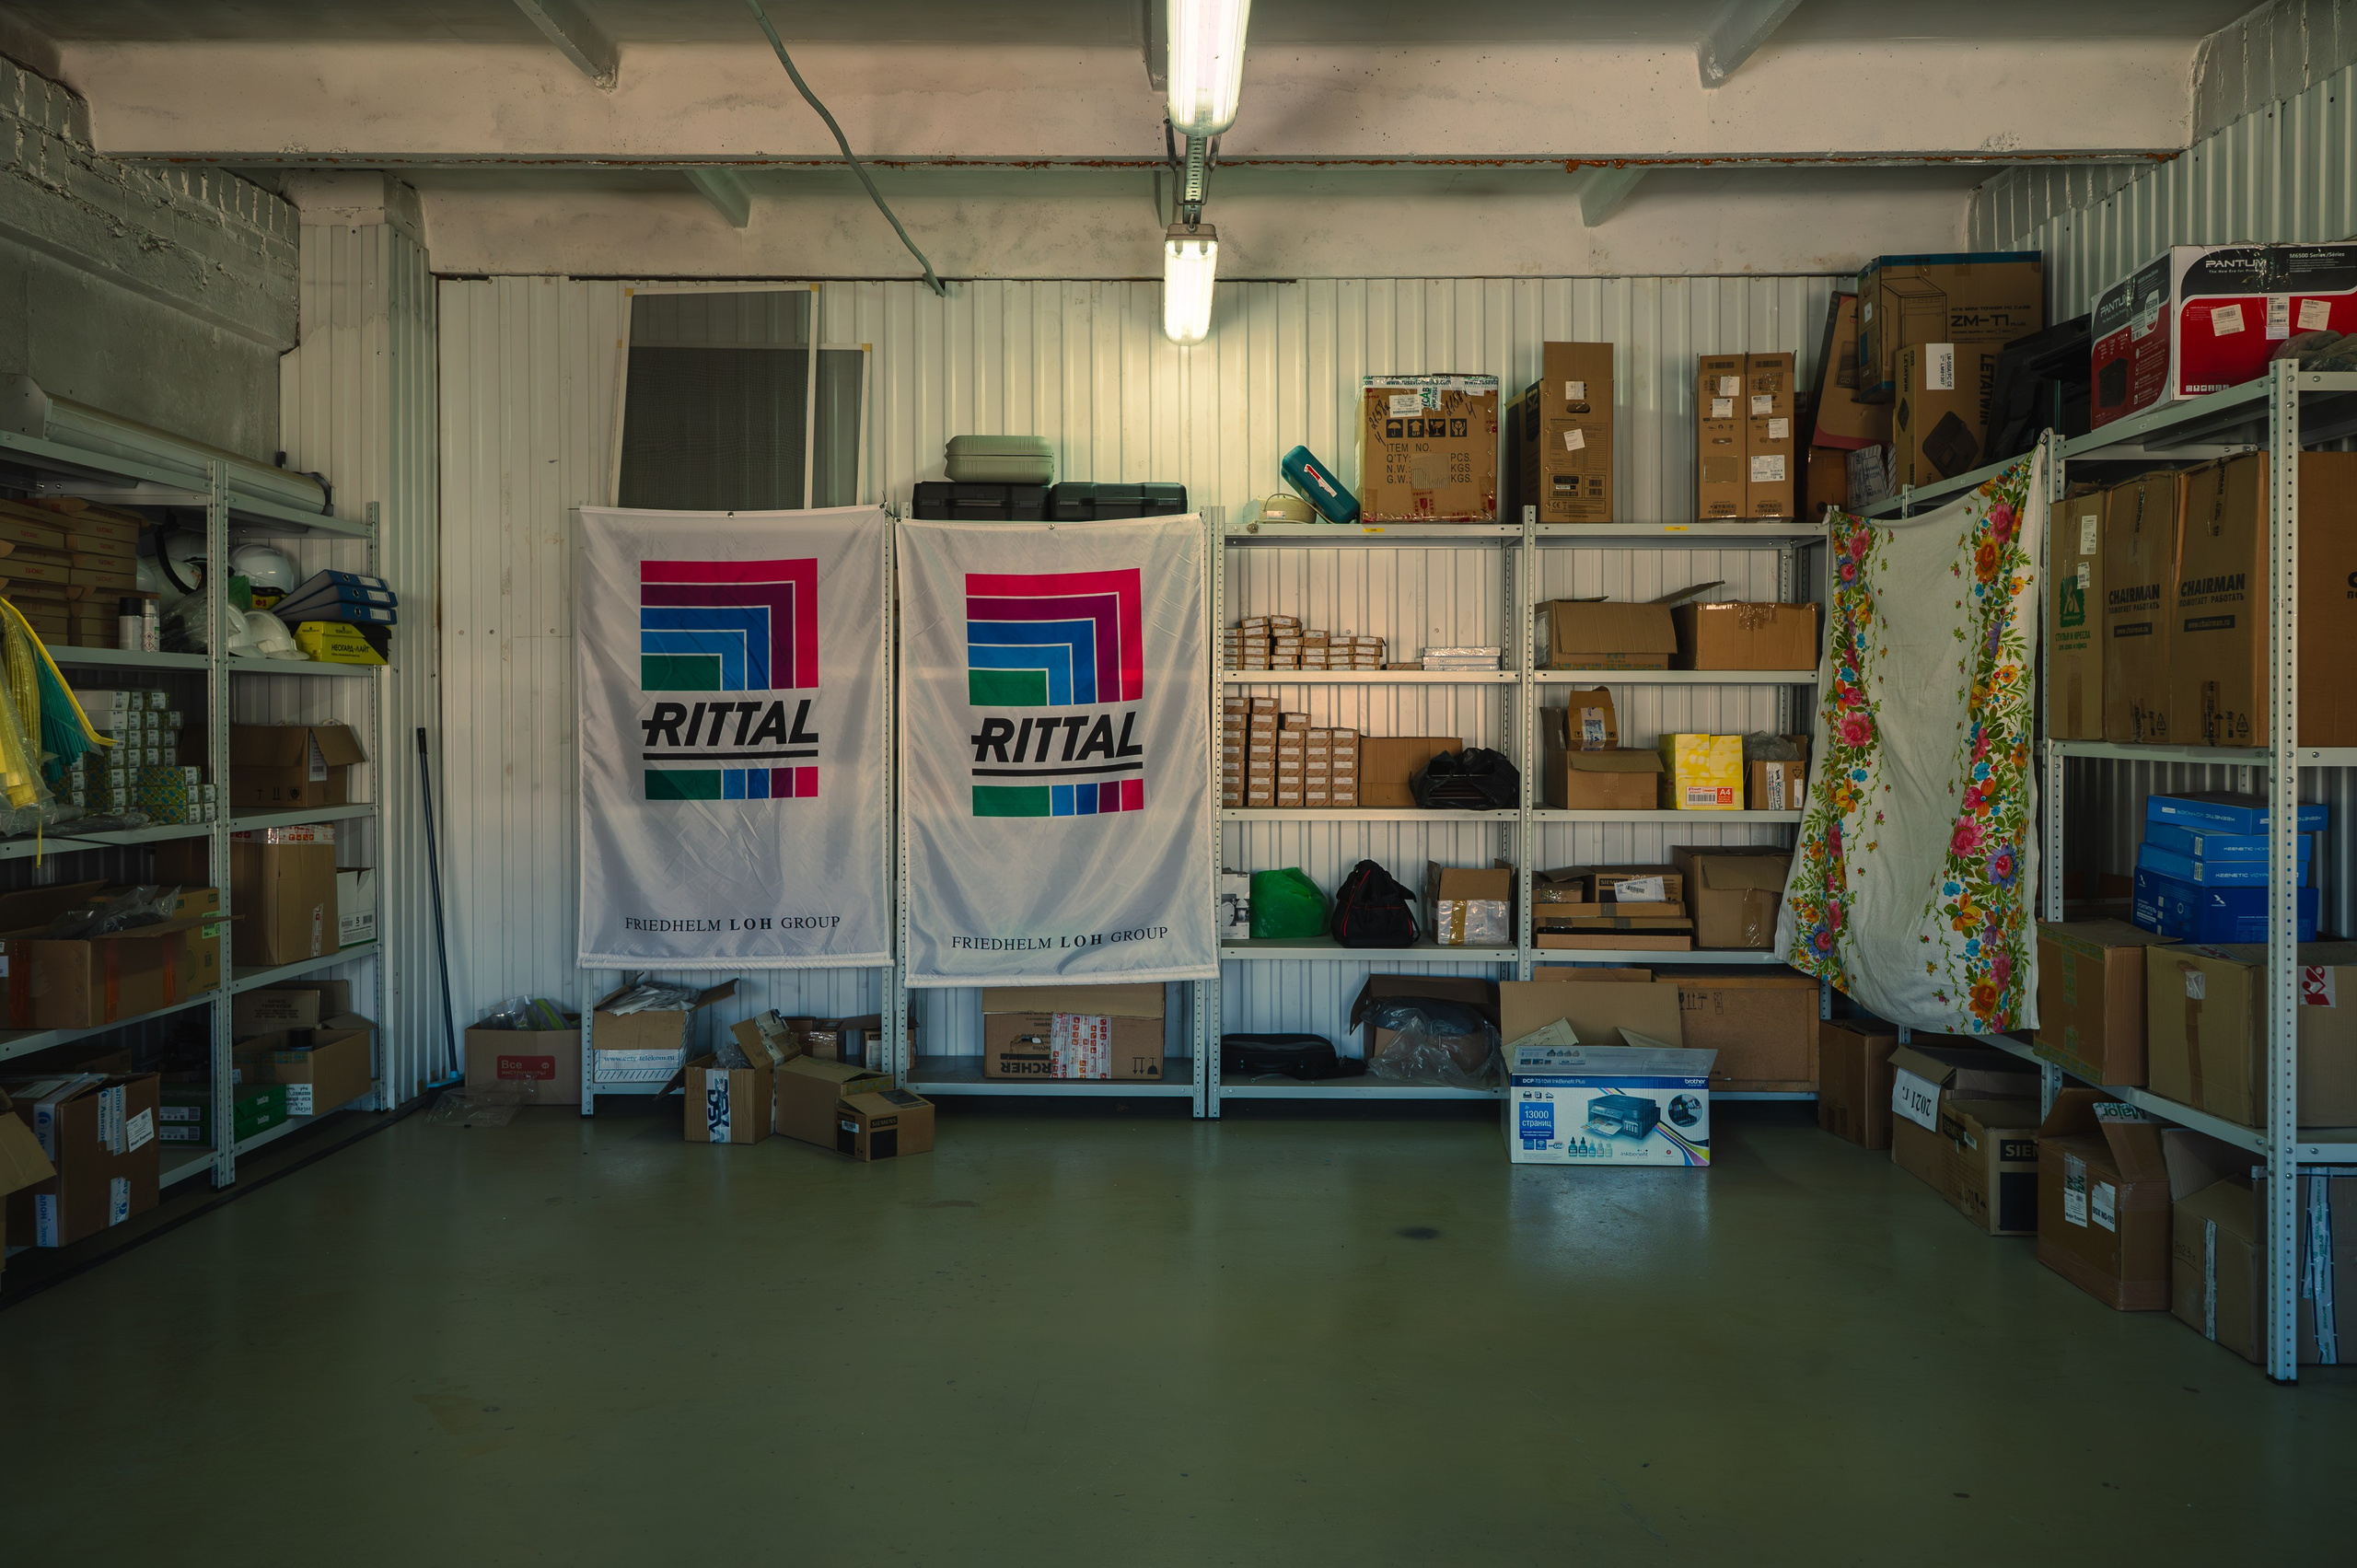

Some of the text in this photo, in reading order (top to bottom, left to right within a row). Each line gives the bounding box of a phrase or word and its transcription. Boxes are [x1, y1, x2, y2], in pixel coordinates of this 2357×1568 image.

[2205, 259, 2267, 268] PANTUM
[1980, 353, 1995, 425] LETATWIN
[1386, 443, 1432, 452] ITEM NO.
[1386, 453, 1472, 463] Q'TY: PCS.
[1450, 464, 1472, 472] KGS.
[1450, 474, 1472, 482] KGS.
[2180, 573, 2247, 597] CHAIRMAN
[2108, 584, 2160, 605] CHAIRMAN
[2179, 592, 2245, 608] ПОМОГАЕТ РАБОТАТЬ
[2108, 601, 2160, 614] ПОМОГАЕТ РАБОТАТЬ
[2073, 631, 2091, 640] КРЕСЛА
[331, 644, 370, 654] НЕОГАРД-ЛАЙТ
[642, 700, 819, 748] RITTAL
[970, 711, 1143, 762] RITTAL
[1720, 788, 1731, 796] A4
[2205, 813, 2235, 822] KEENETIC
[625, 915, 841, 932] FRIEDHELM LOH GROUP
[951, 926, 1167, 951] FRIEDHELM LOH GROUP
[501, 1060, 522, 1069] Все
[1910, 1091, 1932, 1117] 2021
[838, 1112, 855, 1121] SIEMENS
[1525, 1110, 1550, 1119] 13000
[871, 1117, 897, 1127] SIEMENS
[1522, 1120, 1551, 1128] страниц
[2092, 1206, 2101, 1217] BOX
